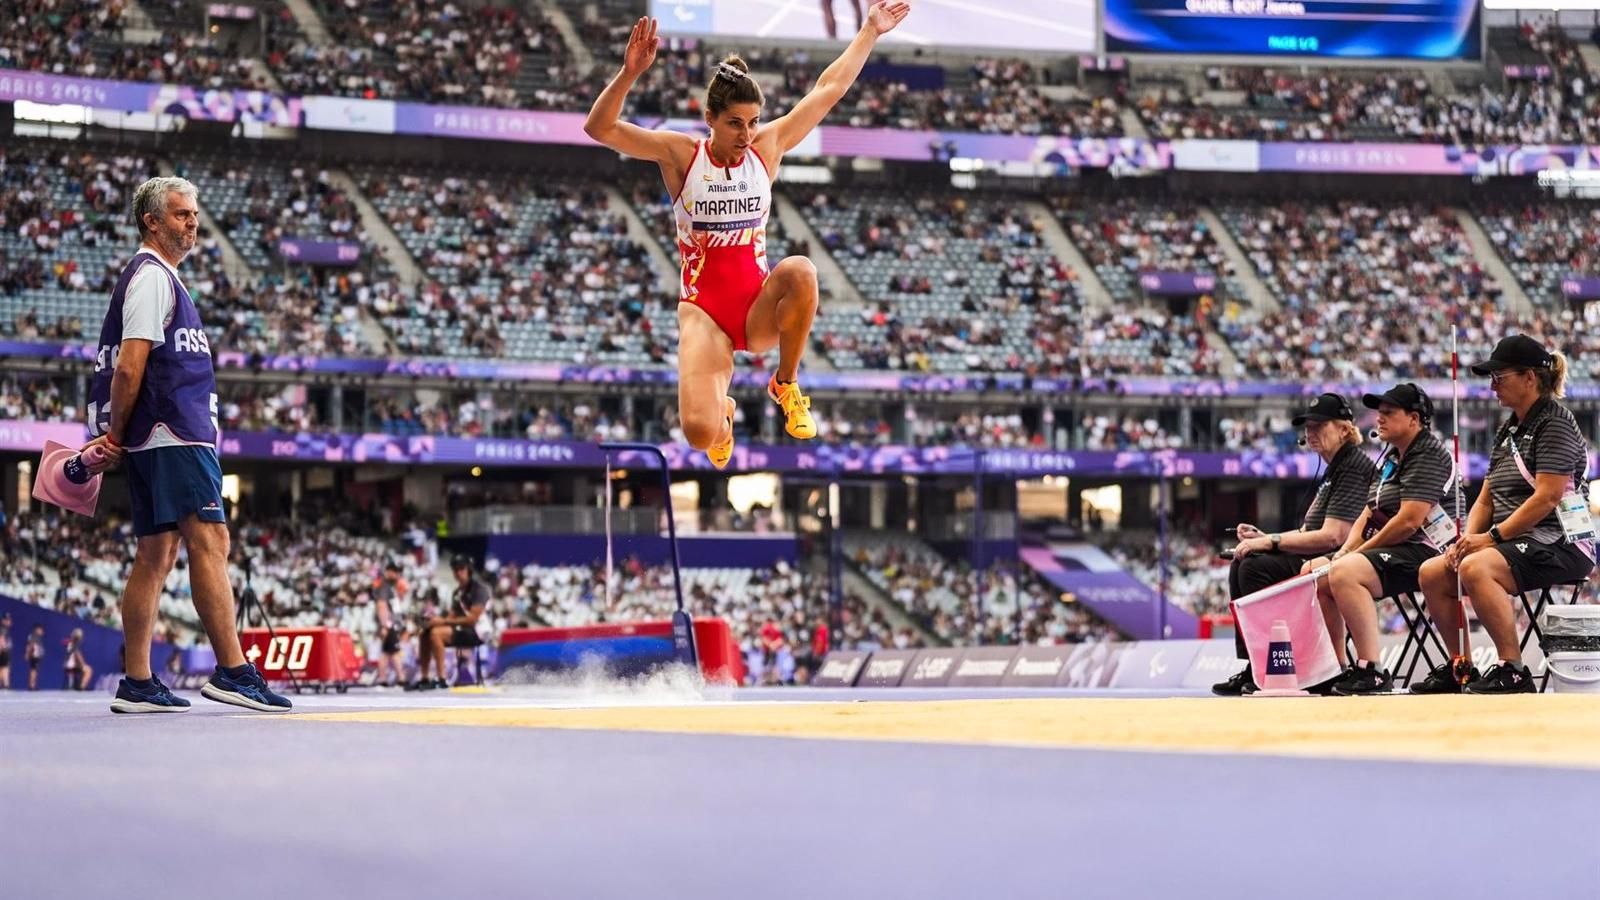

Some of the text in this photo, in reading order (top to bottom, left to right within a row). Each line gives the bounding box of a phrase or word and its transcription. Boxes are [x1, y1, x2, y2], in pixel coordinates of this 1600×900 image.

[52, 82, 106, 103] 2024
[434, 112, 550, 135] PARIS 2024
[1295, 149, 1407, 167] PARIS 2024
[695, 196, 760, 215] MARTINEZ
[475, 443, 574, 461] PARIS 2024
[1031, 454, 1075, 470] 2024
